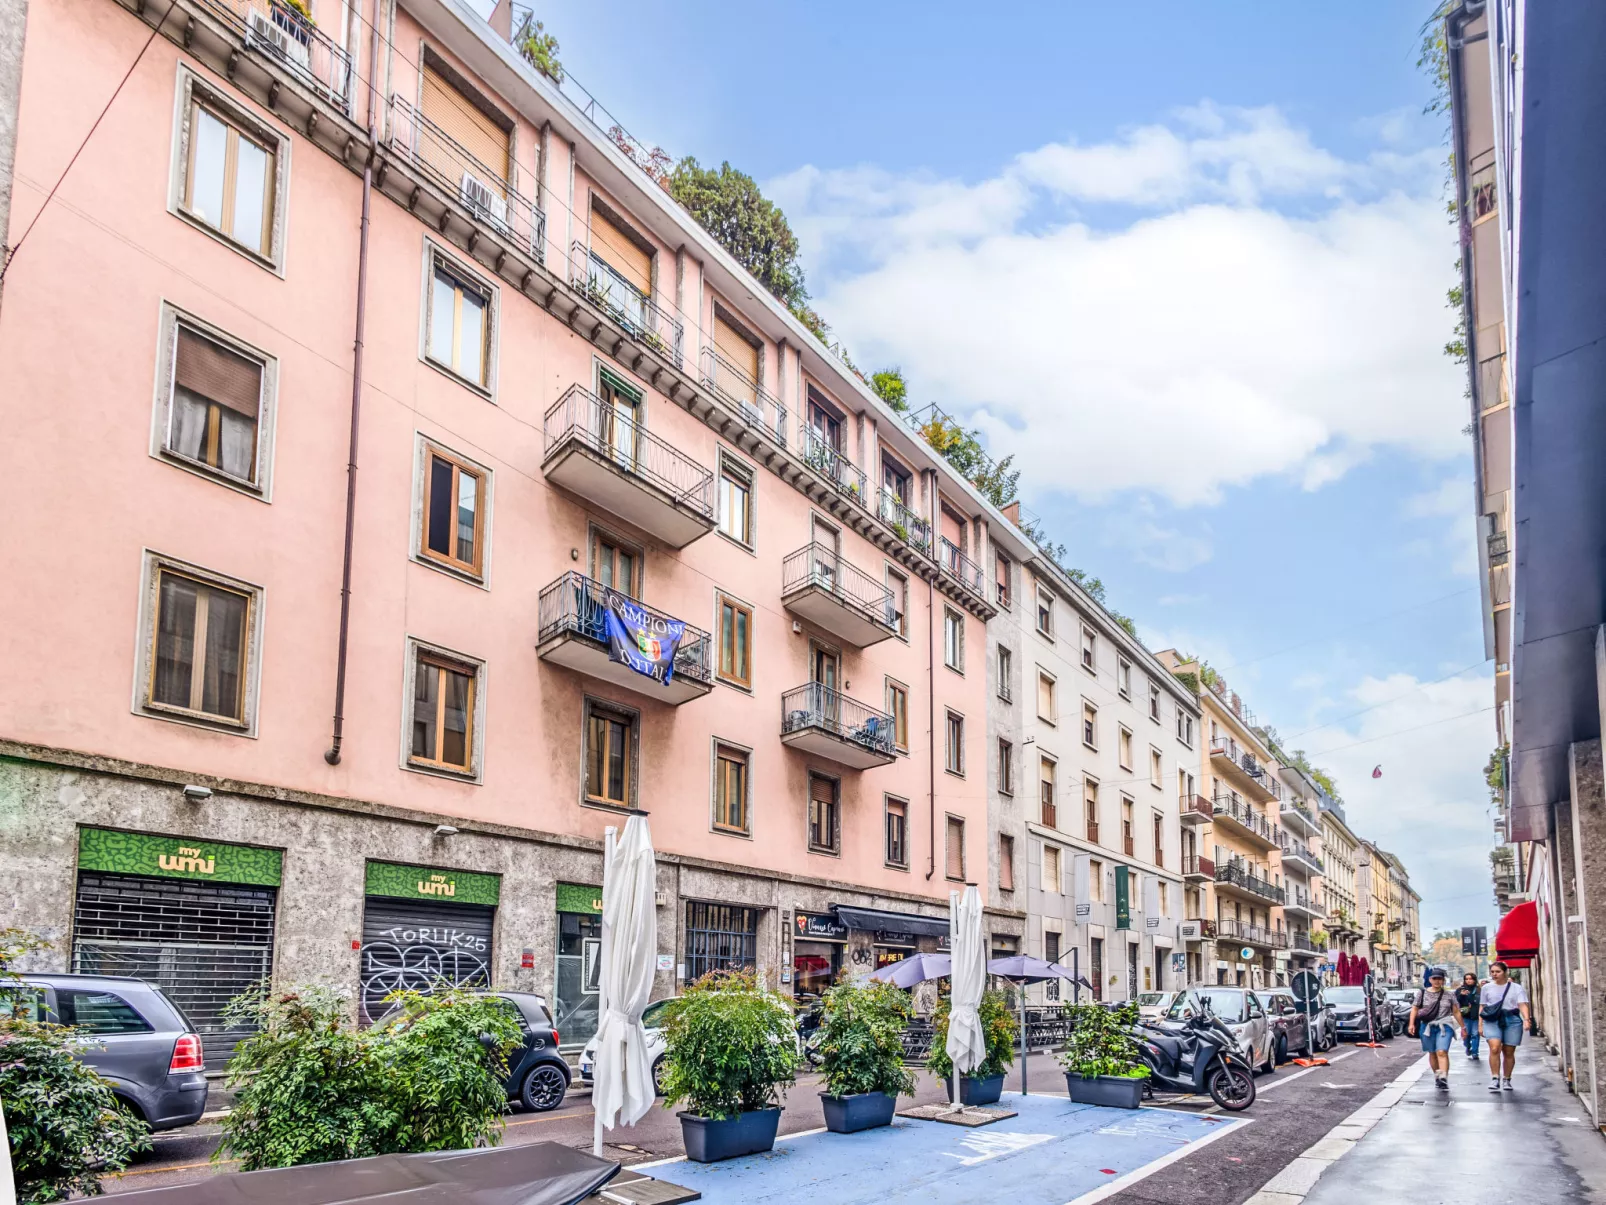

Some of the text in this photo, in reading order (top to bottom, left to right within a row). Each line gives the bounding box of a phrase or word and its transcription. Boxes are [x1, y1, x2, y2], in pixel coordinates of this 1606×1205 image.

[610, 595, 683, 635] CAMPIONI
[620, 649, 664, 683] D'ITAL
[179, 846, 202, 859] my
[158, 854, 215, 874] umi
[417, 880, 456, 897] umi
[430, 874, 447, 885] my
